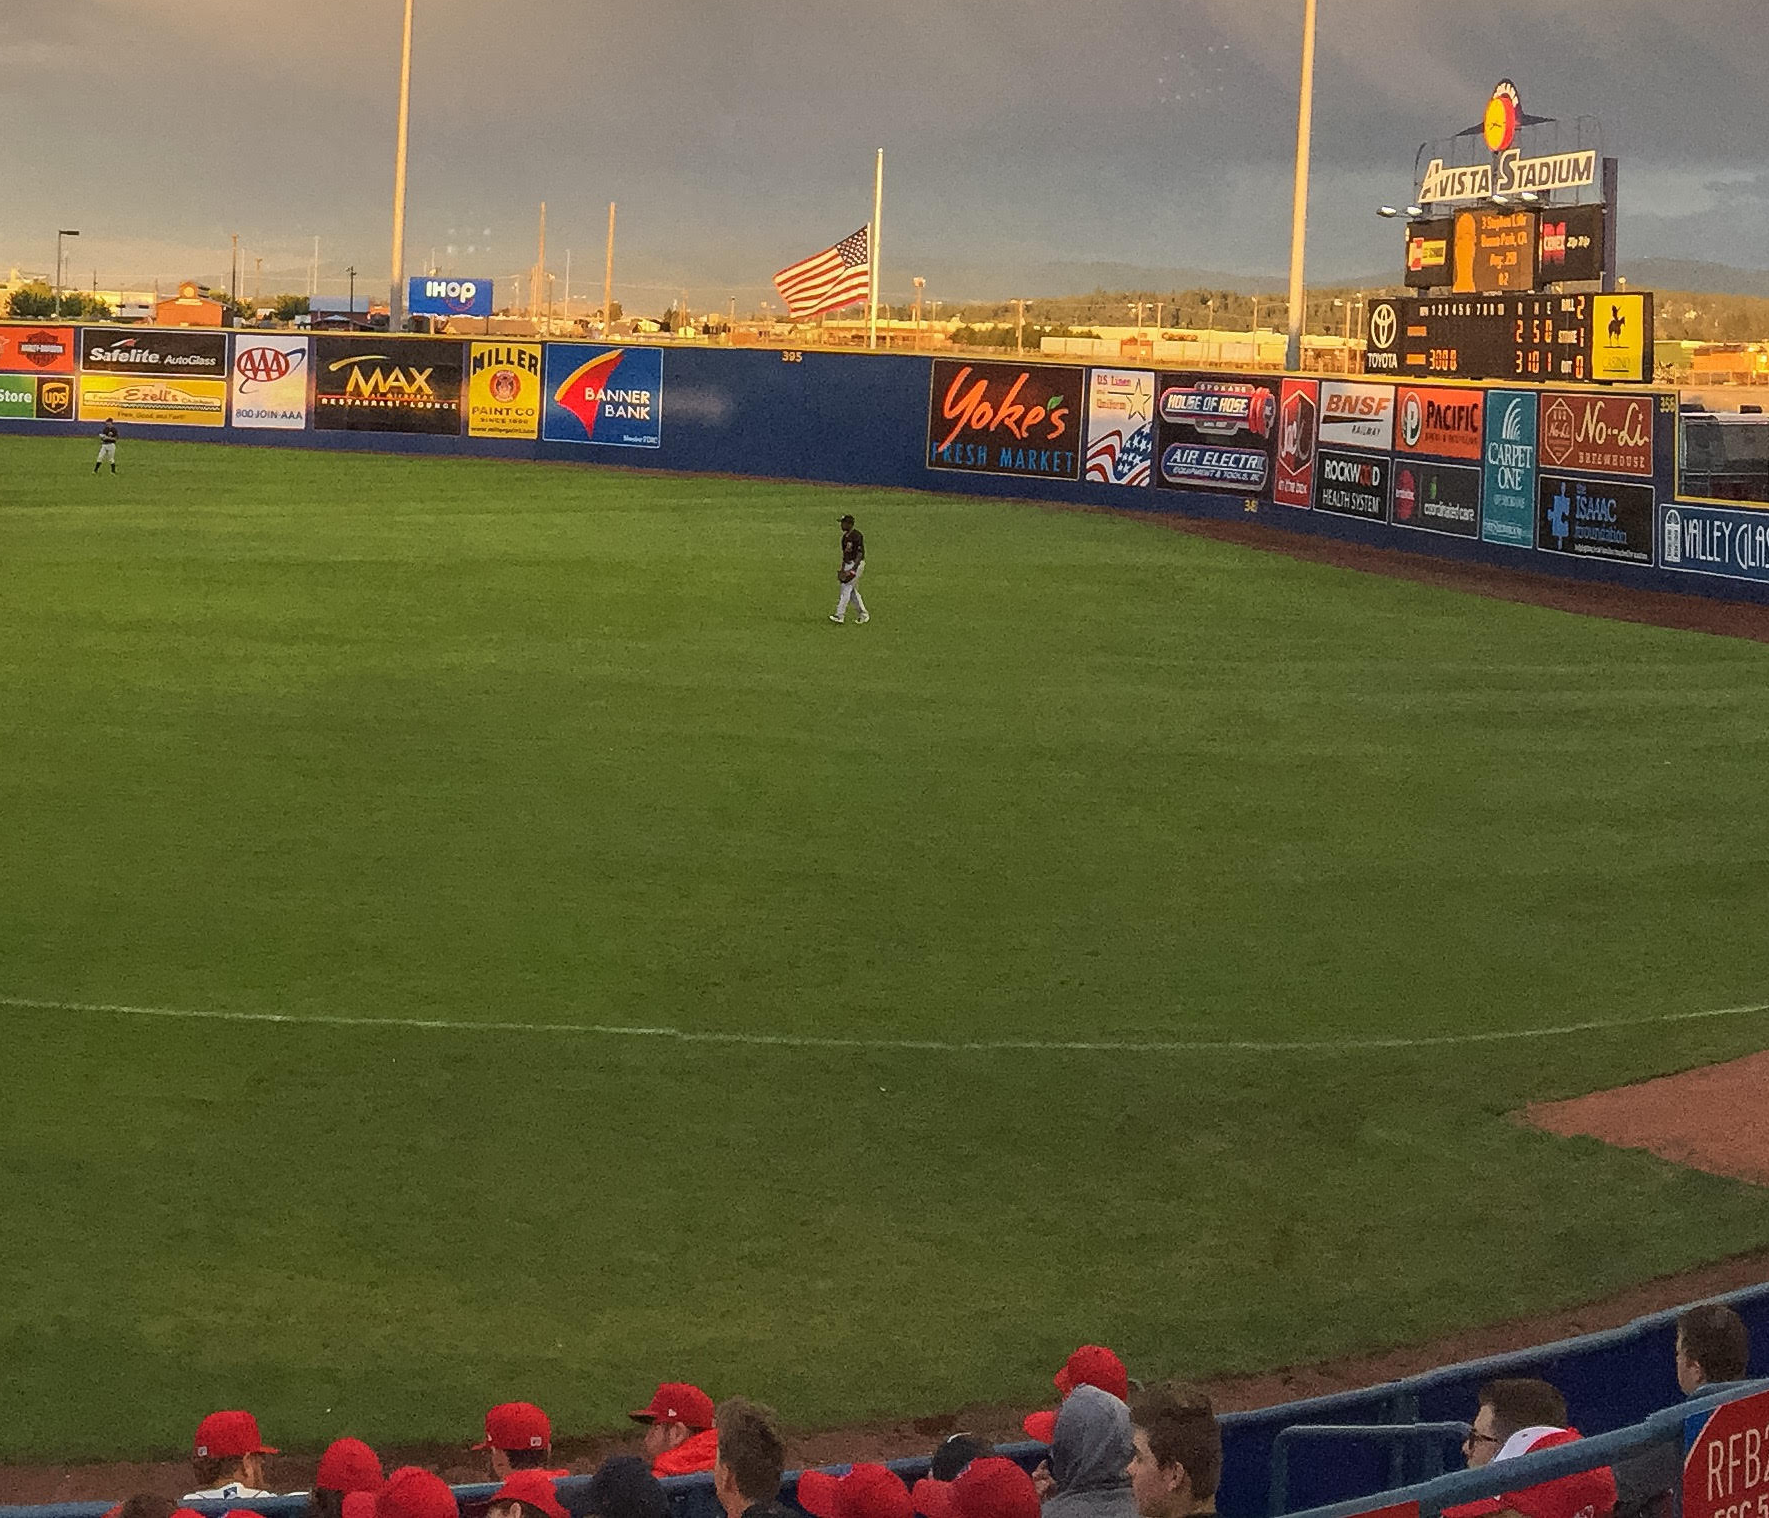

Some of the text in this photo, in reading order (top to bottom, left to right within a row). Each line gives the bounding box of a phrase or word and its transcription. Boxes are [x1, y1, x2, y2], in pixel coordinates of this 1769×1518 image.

[1421, 151, 1593, 200] AVISTA STADIUM
[1576, 296, 1585, 319] 2
[1515, 320, 1540, 343] 2 5
[89, 347, 217, 366] Safelite AutoGlass
[243, 349, 287, 377] AAA
[472, 344, 539, 376] MILLER
[1367, 352, 1398, 368] TOYOTA
[1515, 351, 1523, 373] 3
[346, 366, 434, 397] MAX
[44, 393, 68, 410] ups
[123, 387, 178, 403] Ezell's
[410, 400, 458, 411] LOUNGE
[584, 388, 651, 405] BANNER
[1203, 396, 1217, 411] OF
[1219, 397, 1248, 413] HOSE
[1325, 394, 1391, 417] BNSF
[471, 407, 535, 417] PAINT CO
[604, 405, 651, 420] BANK
[938, 366, 1069, 452] Yoke's
[1426, 399, 1479, 433] PACIFIC
[931, 441, 1075, 473] FRESH MARKET
[1169, 448, 1200, 465] AIR
[1487, 442, 1533, 469] CARPET
[1578, 451, 1645, 468] BREWHOUSE
[1324, 458, 1380, 487] ROCKWOOD
[1497, 467, 1523, 491] ONE
[1322, 488, 1350, 508] HEALTH
[1351, 493, 1381, 514] SYSTEM
[1575, 495, 1617, 522] ISAAC
[1683, 518, 1733, 563] VALLEY
